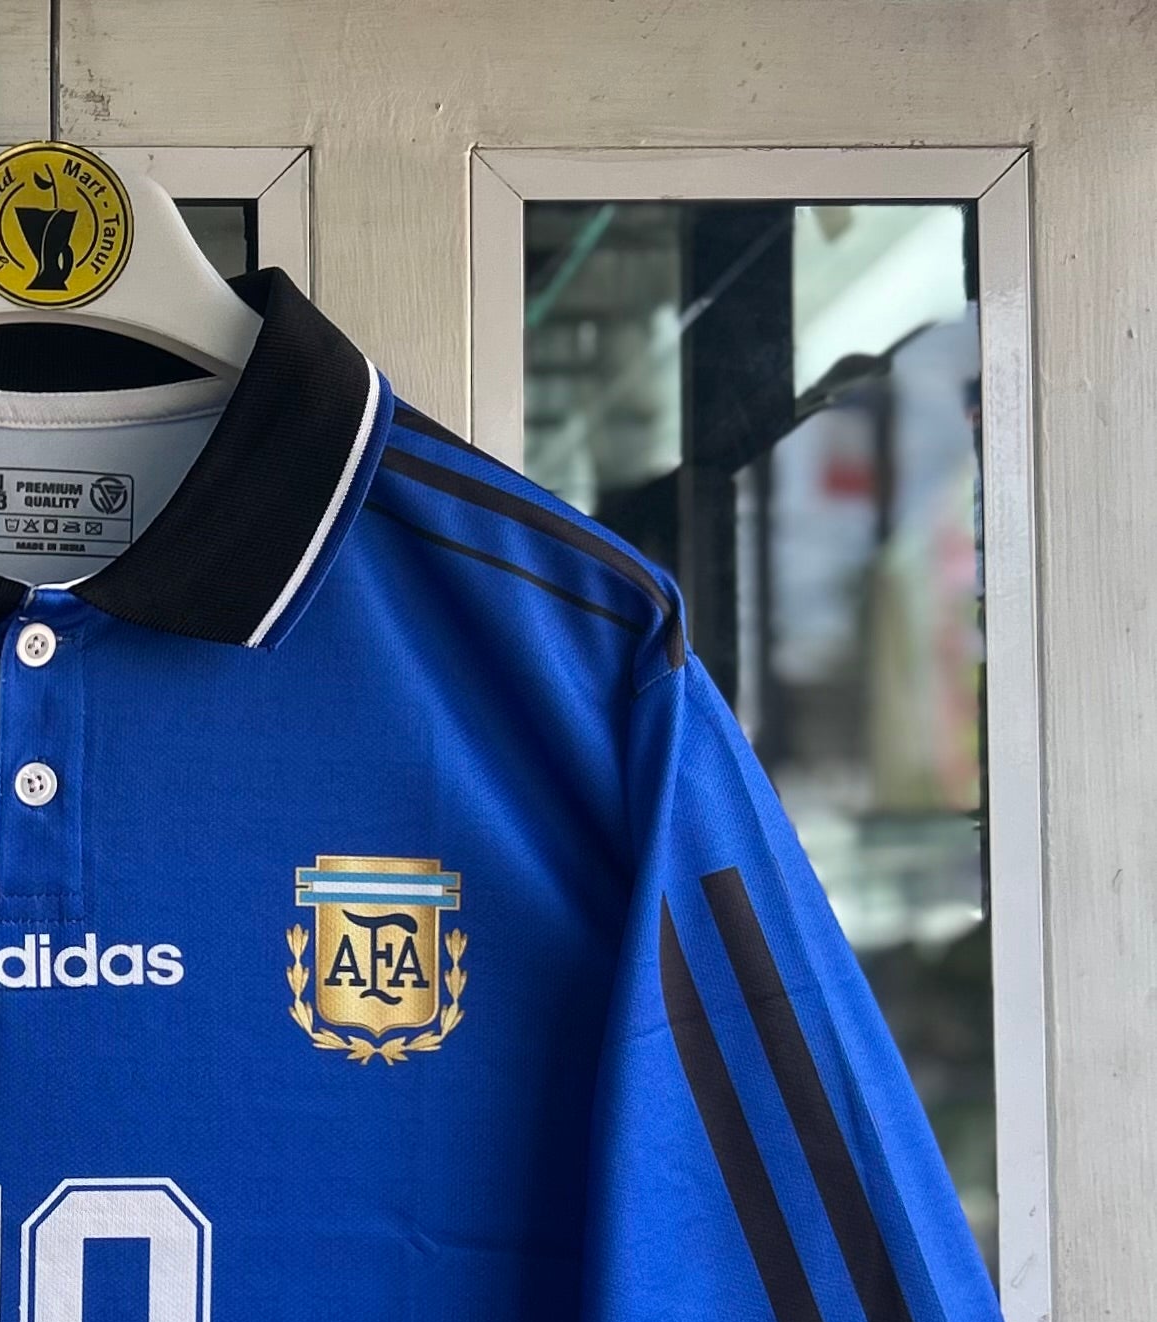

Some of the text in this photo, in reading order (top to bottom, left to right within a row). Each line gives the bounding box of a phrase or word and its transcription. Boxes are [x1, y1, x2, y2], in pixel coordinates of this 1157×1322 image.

[63, 159, 107, 198] Mart
[90, 213, 121, 275] Tanur
[16, 481, 83, 496] PREMIUM
[24, 496, 80, 509] QUALITY
[16, 541, 44, 550] MADE
[47, 542, 57, 551] IN
[324, 909, 430, 1005] AFA
